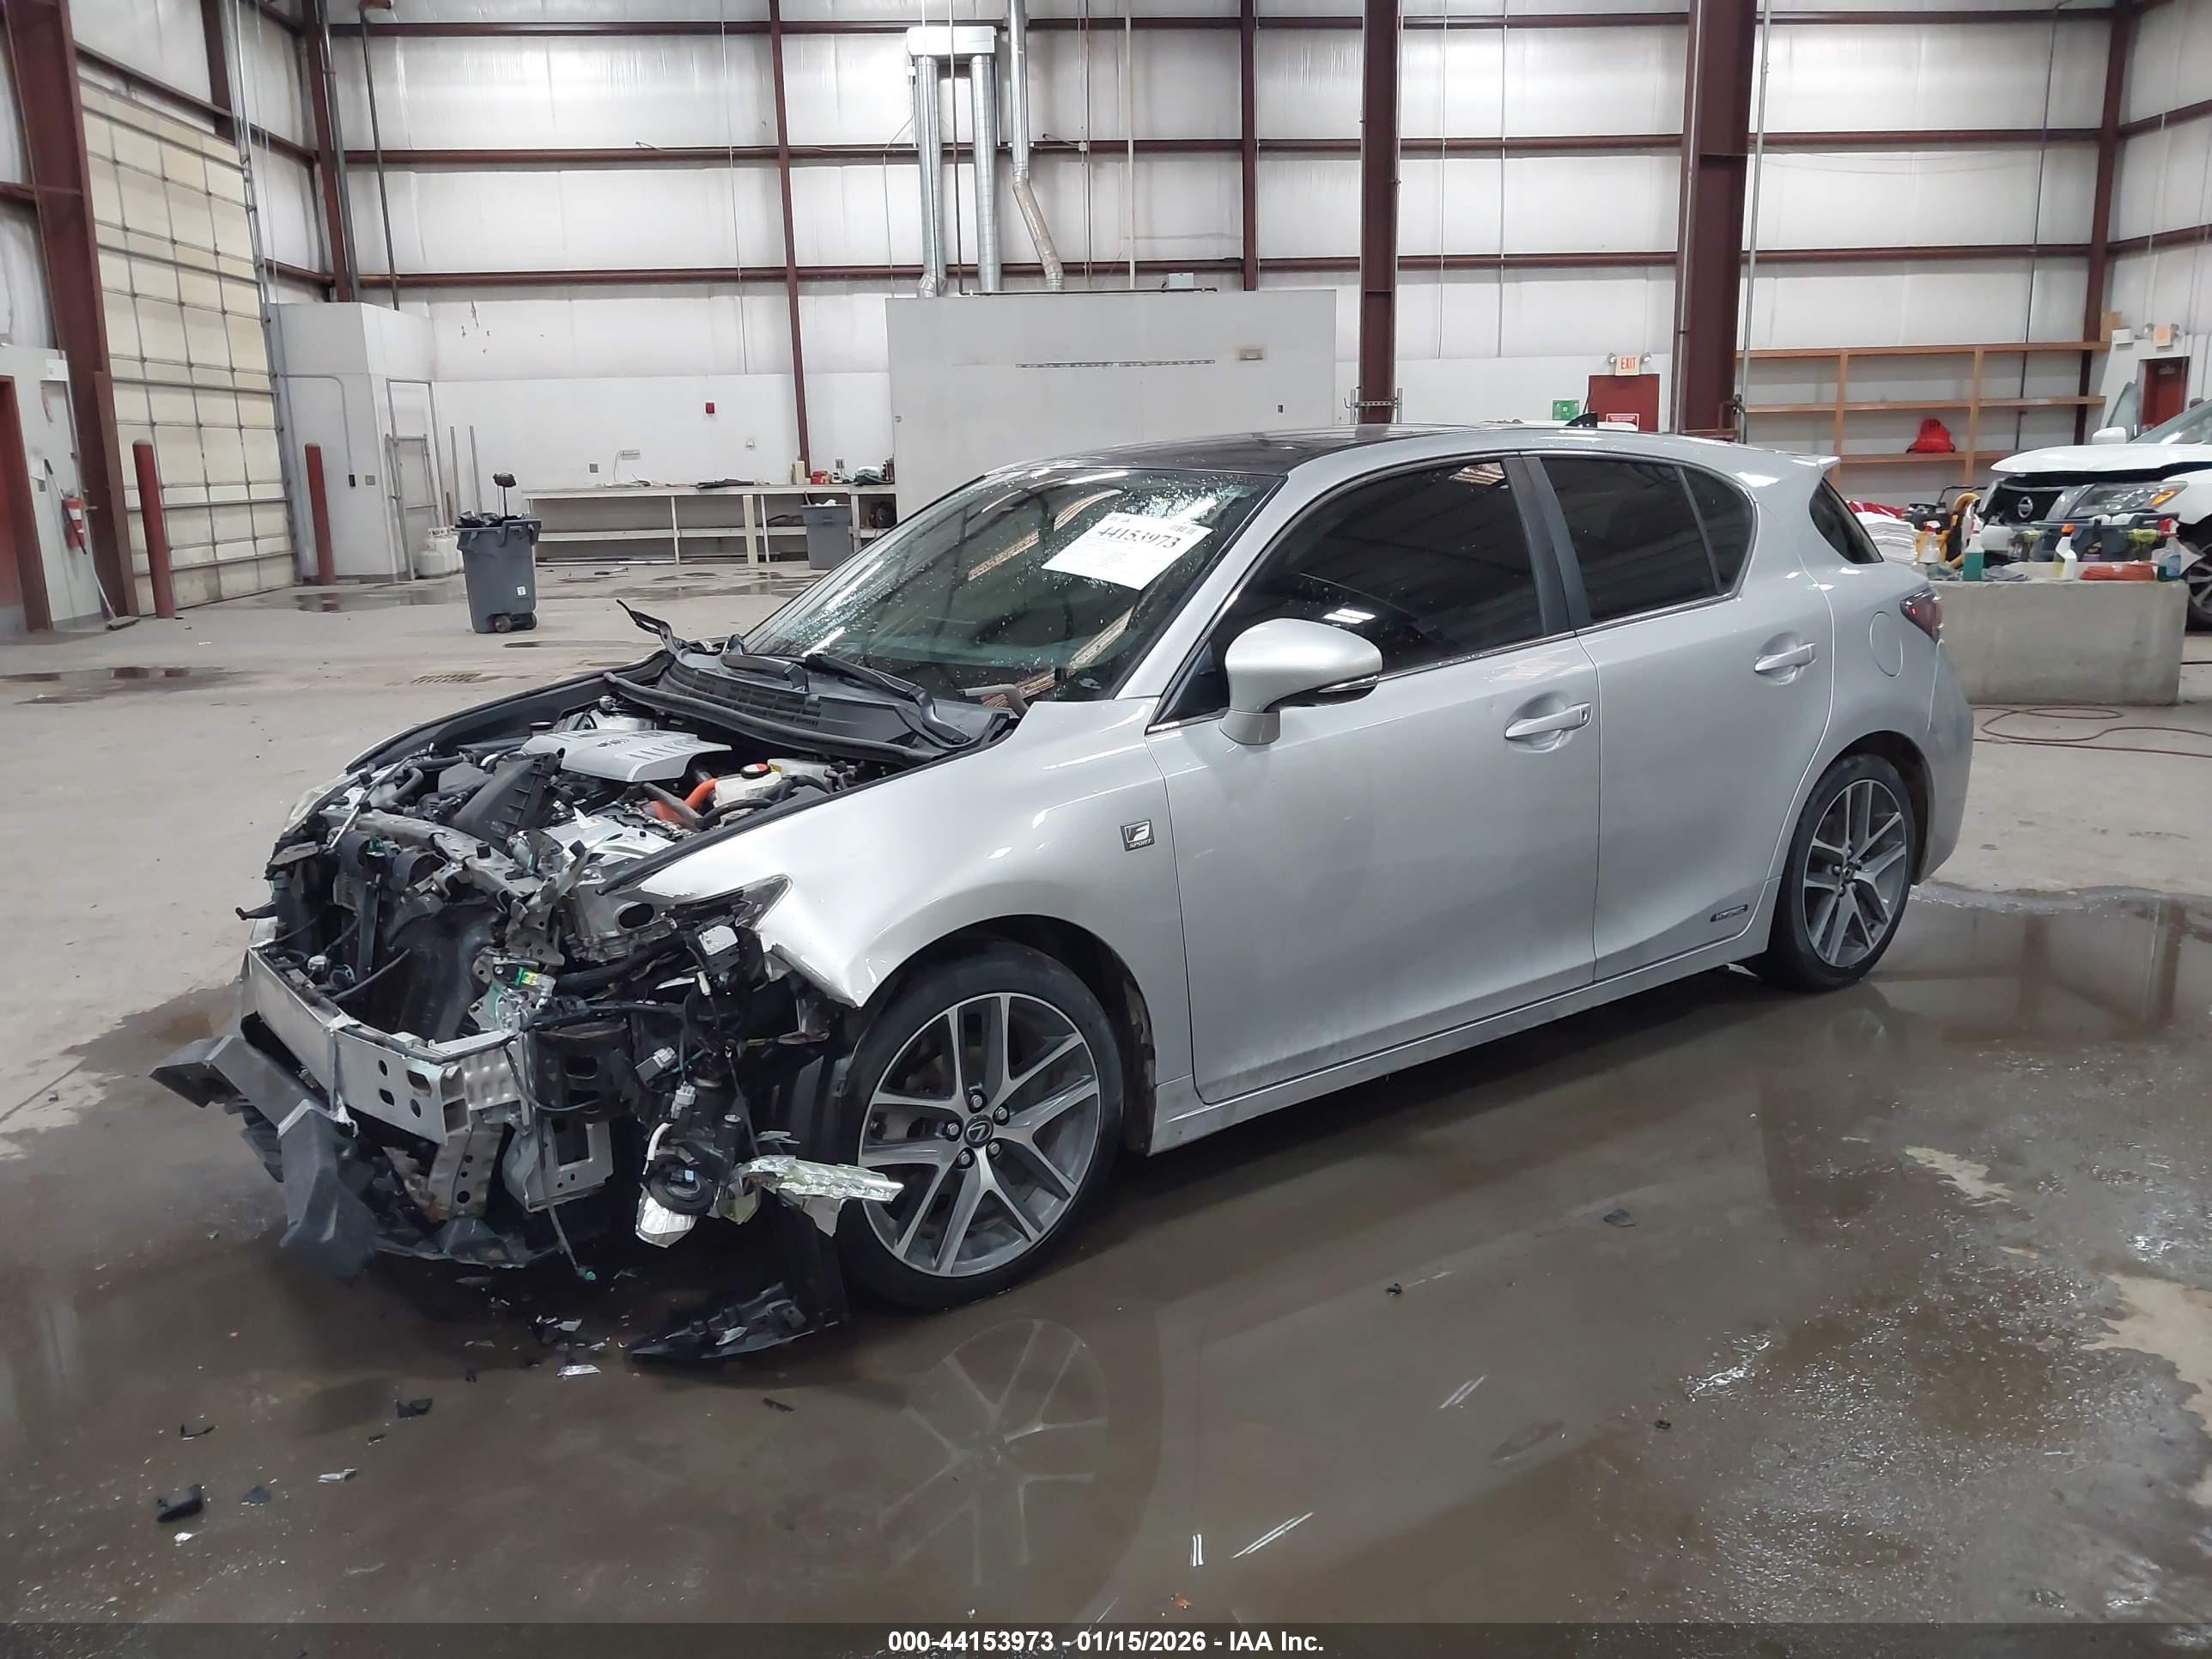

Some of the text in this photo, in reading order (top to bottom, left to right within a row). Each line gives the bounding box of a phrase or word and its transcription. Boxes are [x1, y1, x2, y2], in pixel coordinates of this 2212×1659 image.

[1621, 357, 1636, 369] EXIT
[1098, 526, 1182, 548] 44153973
[1129, 838, 1152, 848] SPORT
